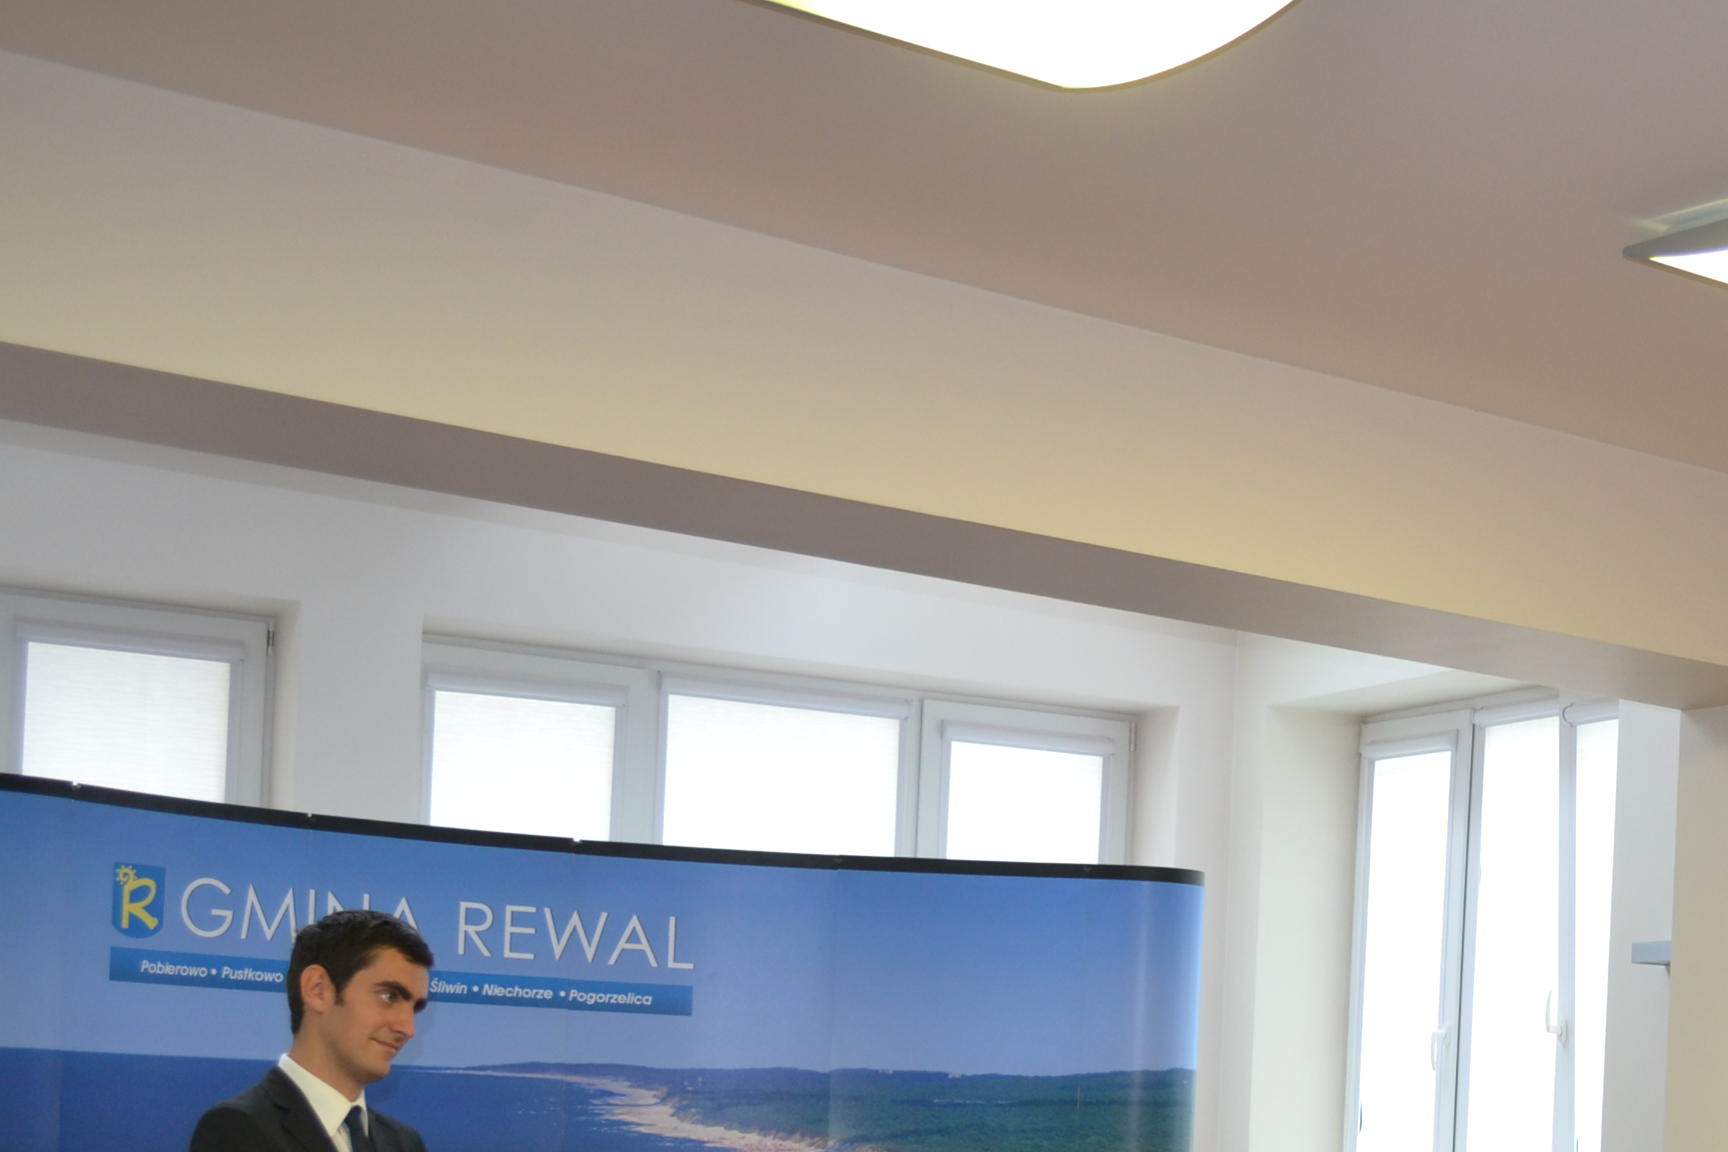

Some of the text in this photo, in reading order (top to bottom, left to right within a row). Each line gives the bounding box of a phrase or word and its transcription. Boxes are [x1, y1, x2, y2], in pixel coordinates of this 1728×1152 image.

[457, 901, 694, 969] REWAL
[140, 960, 652, 1006] Pobierowo Pustkowo Śliwin Niechorze Pogorzelica
